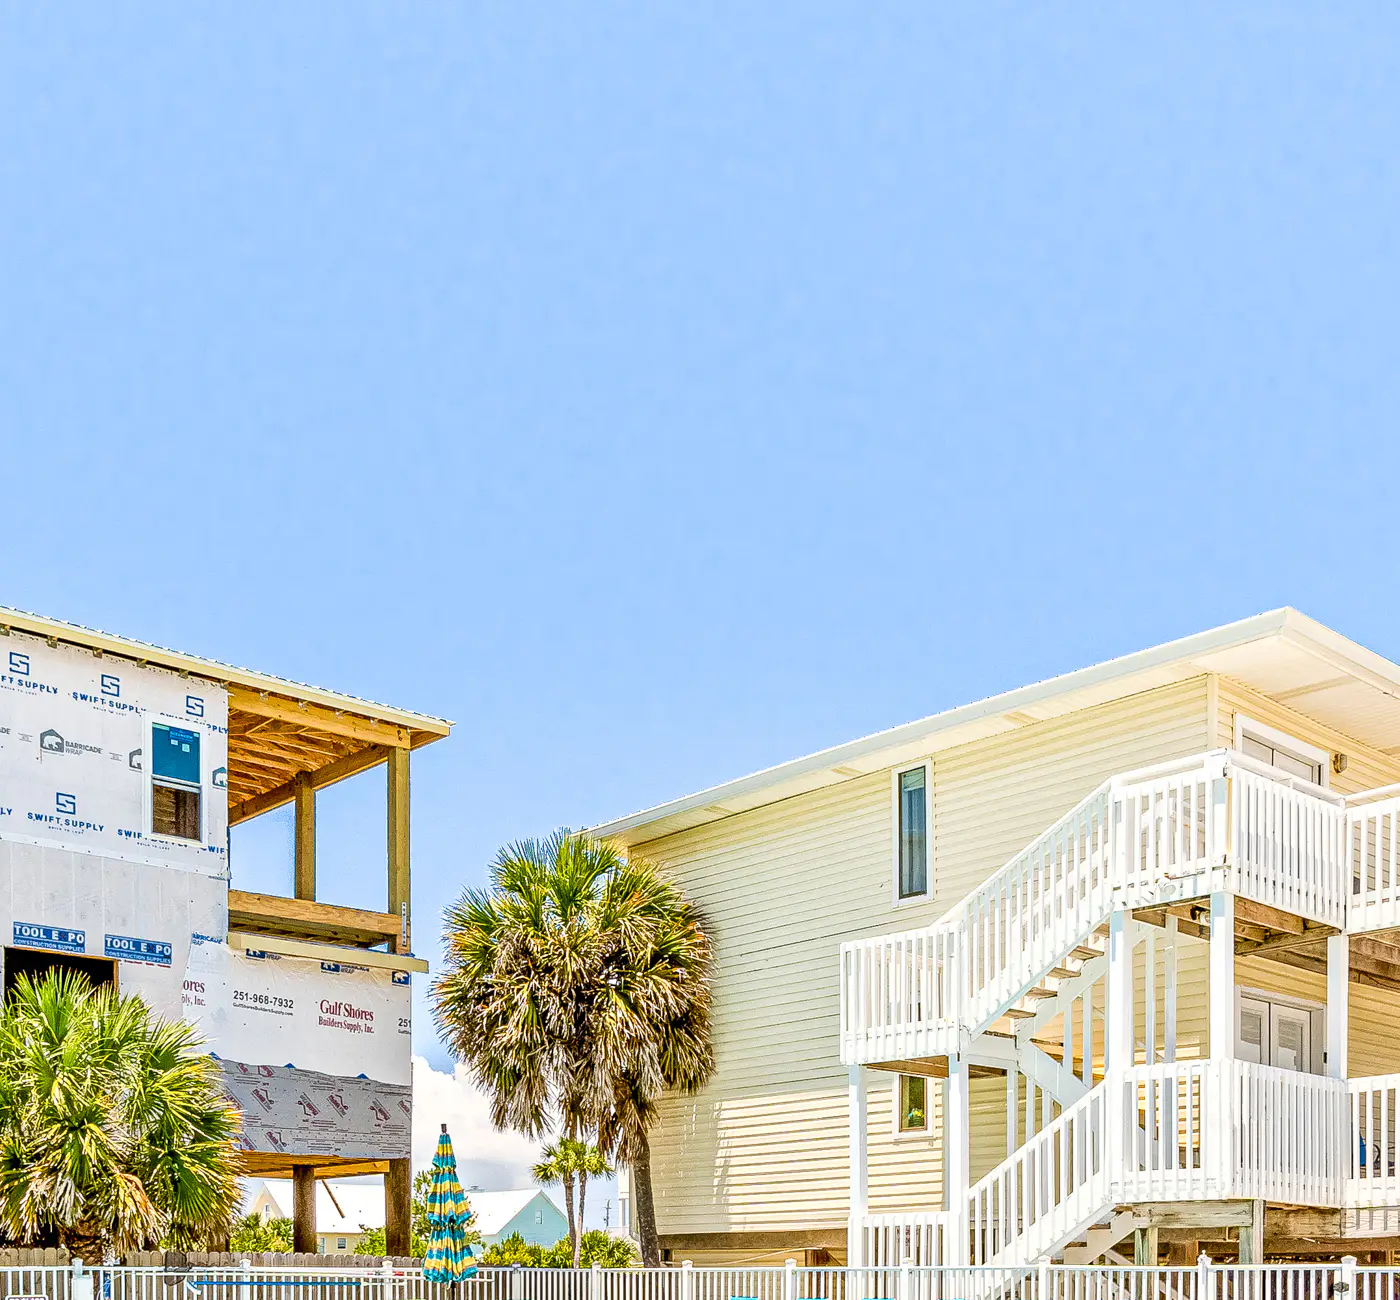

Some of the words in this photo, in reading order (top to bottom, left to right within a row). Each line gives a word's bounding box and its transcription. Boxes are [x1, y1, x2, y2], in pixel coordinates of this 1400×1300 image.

[17, 678, 58, 694] SUPPLY
[72, 691, 106, 705] SWIFT
[65, 741, 103, 754] BARRICADE
[27, 812, 61, 824] SWIFT
[64, 819, 104, 832] SUPPLY
[117, 828, 147, 840] SWIF
[14, 925, 47, 939] TOOL
[13, 938, 57, 949] CONSTRUCTION
[57, 944, 84, 953] SUPPLIES
[105, 937, 136, 951] TOOL
[105, 950, 146, 960] CONSTRUCTION
[146, 955, 171, 964] SUPPLIES
[182, 979, 206, 994] ores
[233, 990, 294, 1009] 251-968-7932
[320, 999, 343, 1016] Gulf
[343, 1002, 375, 1021] Shores
[364, 1023, 375, 1034] Inc.
